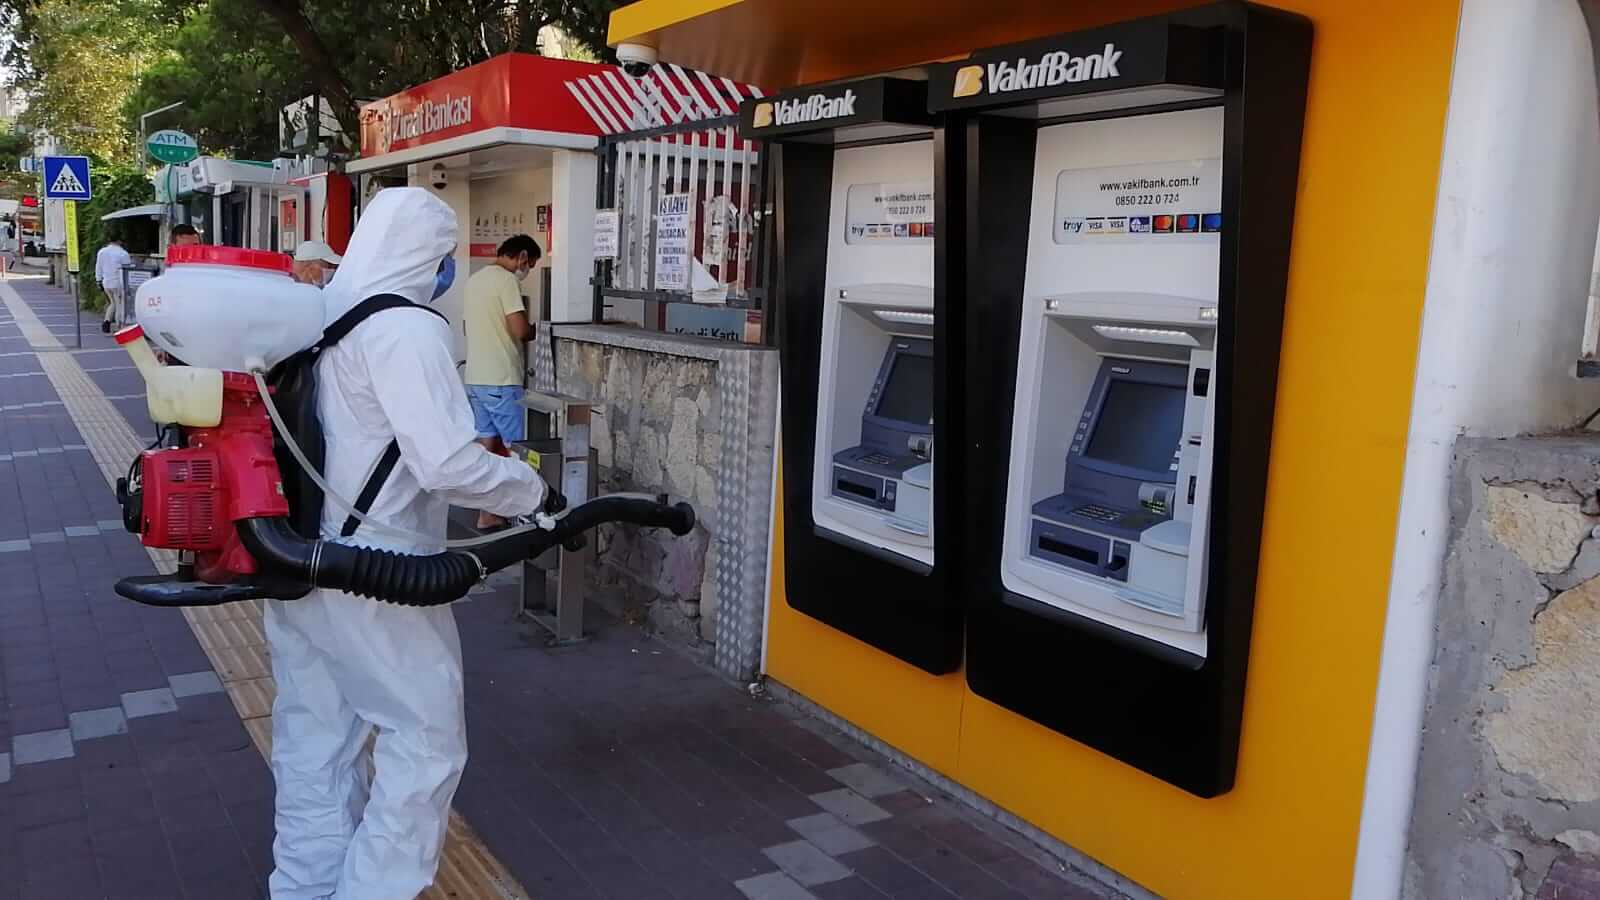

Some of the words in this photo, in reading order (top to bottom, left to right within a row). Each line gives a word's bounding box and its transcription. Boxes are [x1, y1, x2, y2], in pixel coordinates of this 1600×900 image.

[157, 134, 186, 145] ATM
[1100, 176, 1200, 192] www.vakifbank.com.tr
[1115, 195, 1136, 206] 0850
[1137, 195, 1154, 205] 222
[1155, 194, 1161, 205] 0
[1063, 219, 1083, 232] troy
[1088, 221, 1103, 230] VISA
[1109, 220, 1124, 229] VISA
